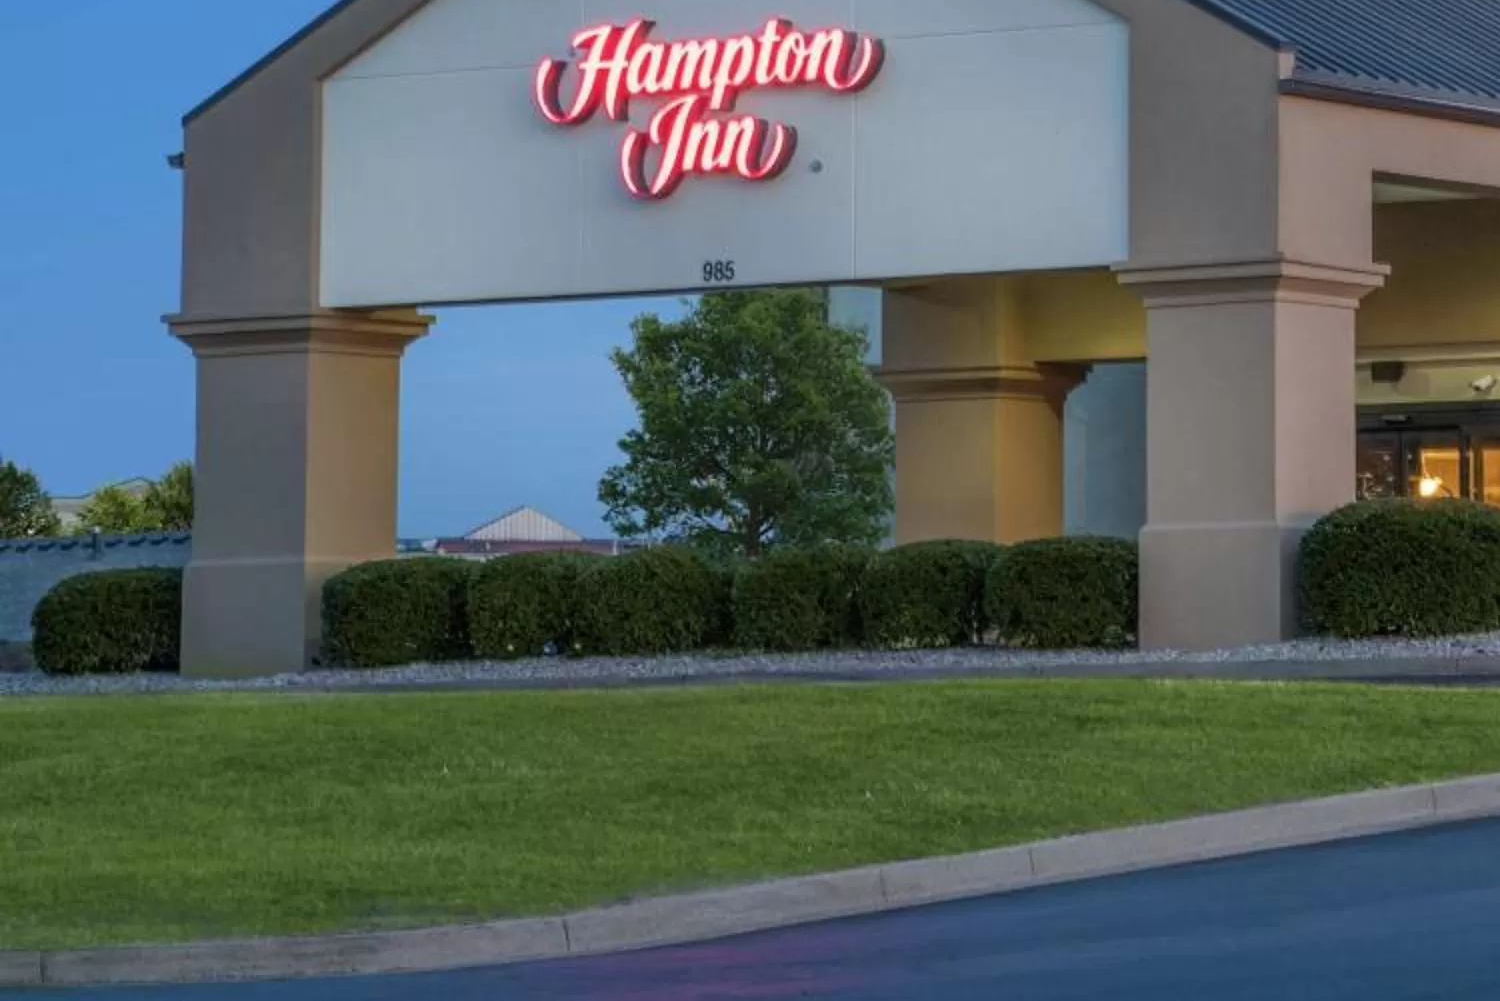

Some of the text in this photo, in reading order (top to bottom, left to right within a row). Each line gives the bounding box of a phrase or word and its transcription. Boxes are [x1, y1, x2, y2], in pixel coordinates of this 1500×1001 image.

[535, 18, 885, 124] Hampton
[619, 94, 798, 199] Inn
[702, 259, 736, 283] 985
